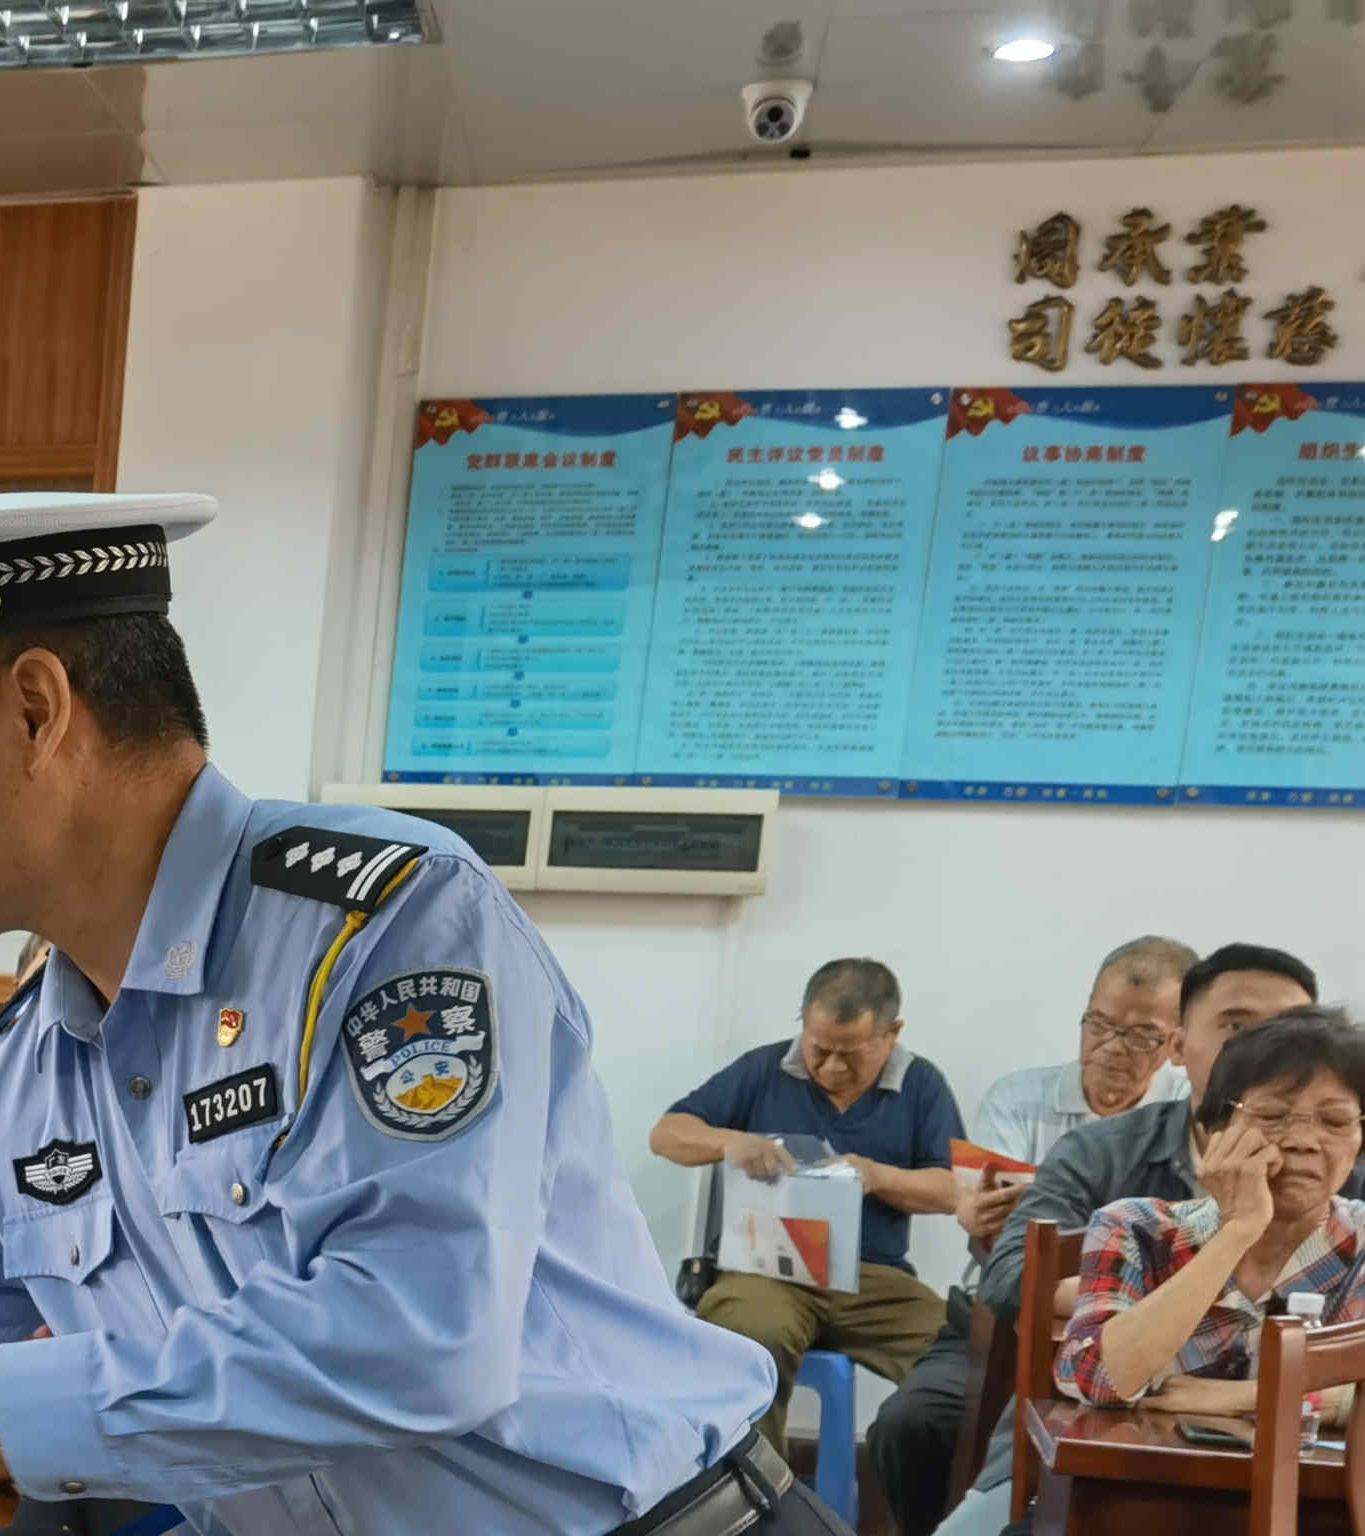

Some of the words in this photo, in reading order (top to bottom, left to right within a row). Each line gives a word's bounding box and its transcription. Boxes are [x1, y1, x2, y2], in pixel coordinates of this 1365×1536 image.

[346, 975, 482, 1038] 中华人民共和国
[389, 1040, 452, 1067] POLICE
[190, 1077, 267, 1132] 173207
